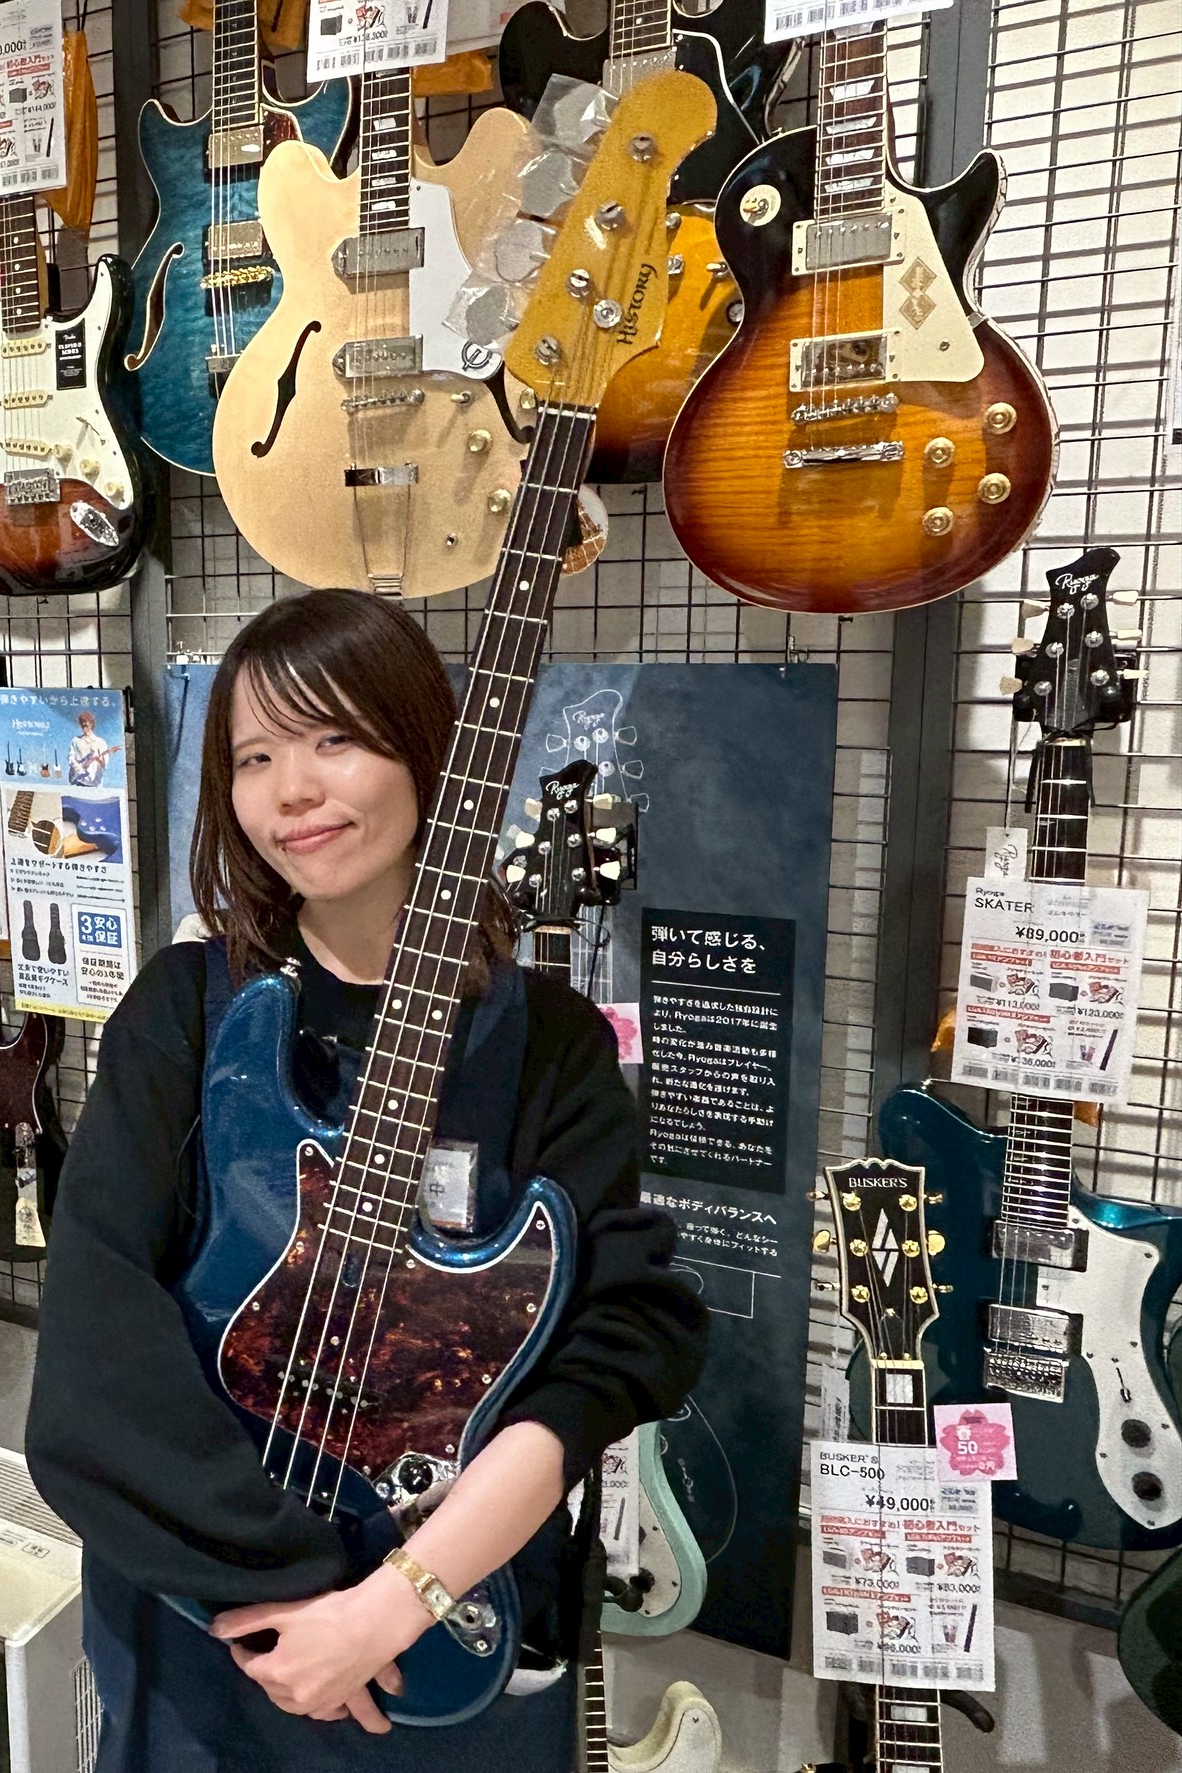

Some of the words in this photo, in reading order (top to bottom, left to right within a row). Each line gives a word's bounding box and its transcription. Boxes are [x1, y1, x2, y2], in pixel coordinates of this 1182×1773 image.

[1055, 573, 1099, 595] Ryoga
[974, 897, 1035, 914] SKATER
[80, 915, 93, 934] 3
[94, 916, 118, 930] 安心
[95, 930, 119, 945] 保証
[651, 925, 765, 950] 弾いて感じる、
[1016, 926, 1079, 943] ¥89,000
[652, 949, 756, 974] 自分らしさを
[848, 1177, 908, 1188] BUSKER'S
[957, 1440, 978, 1455] 50
[820, 1463, 886, 1480] BLC-500
[865, 1494, 930, 1511] ¥49,000
